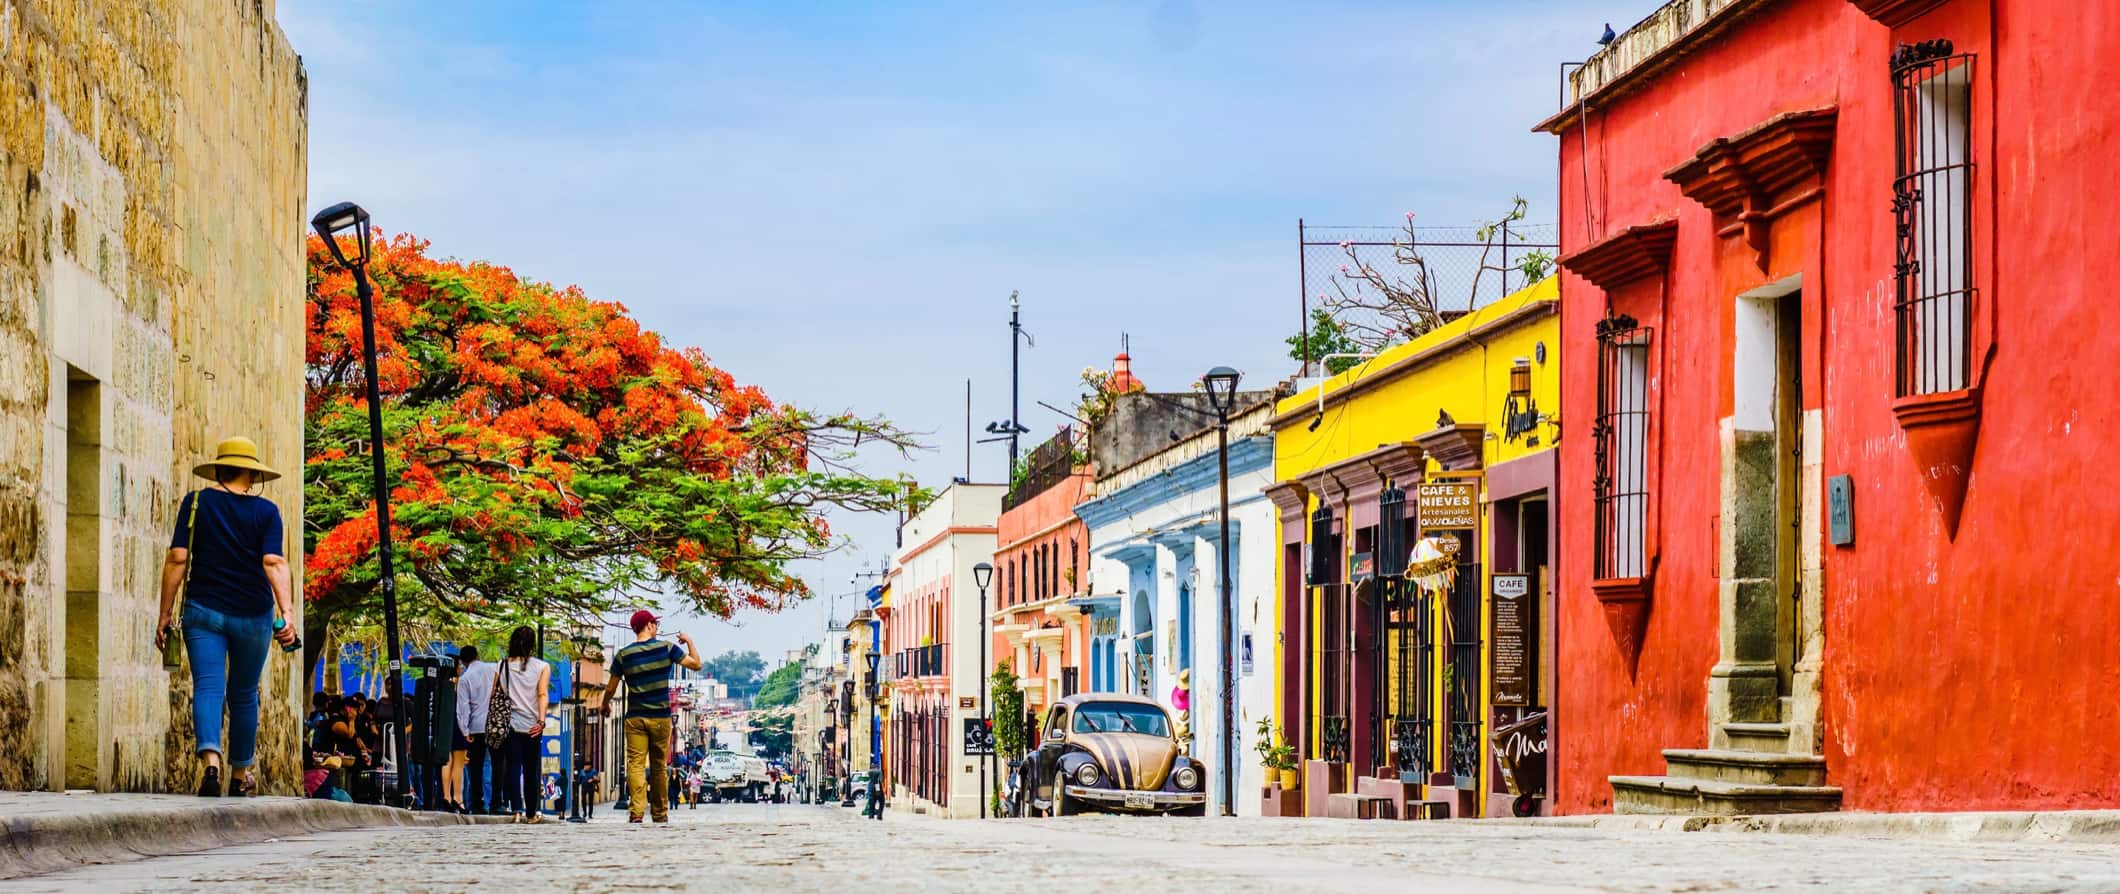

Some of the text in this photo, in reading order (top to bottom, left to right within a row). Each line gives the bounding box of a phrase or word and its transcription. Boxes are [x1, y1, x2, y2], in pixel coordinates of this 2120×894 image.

[1421, 486, 1467, 495] CAFE &
[1421, 496, 1470, 506] NIEVES
